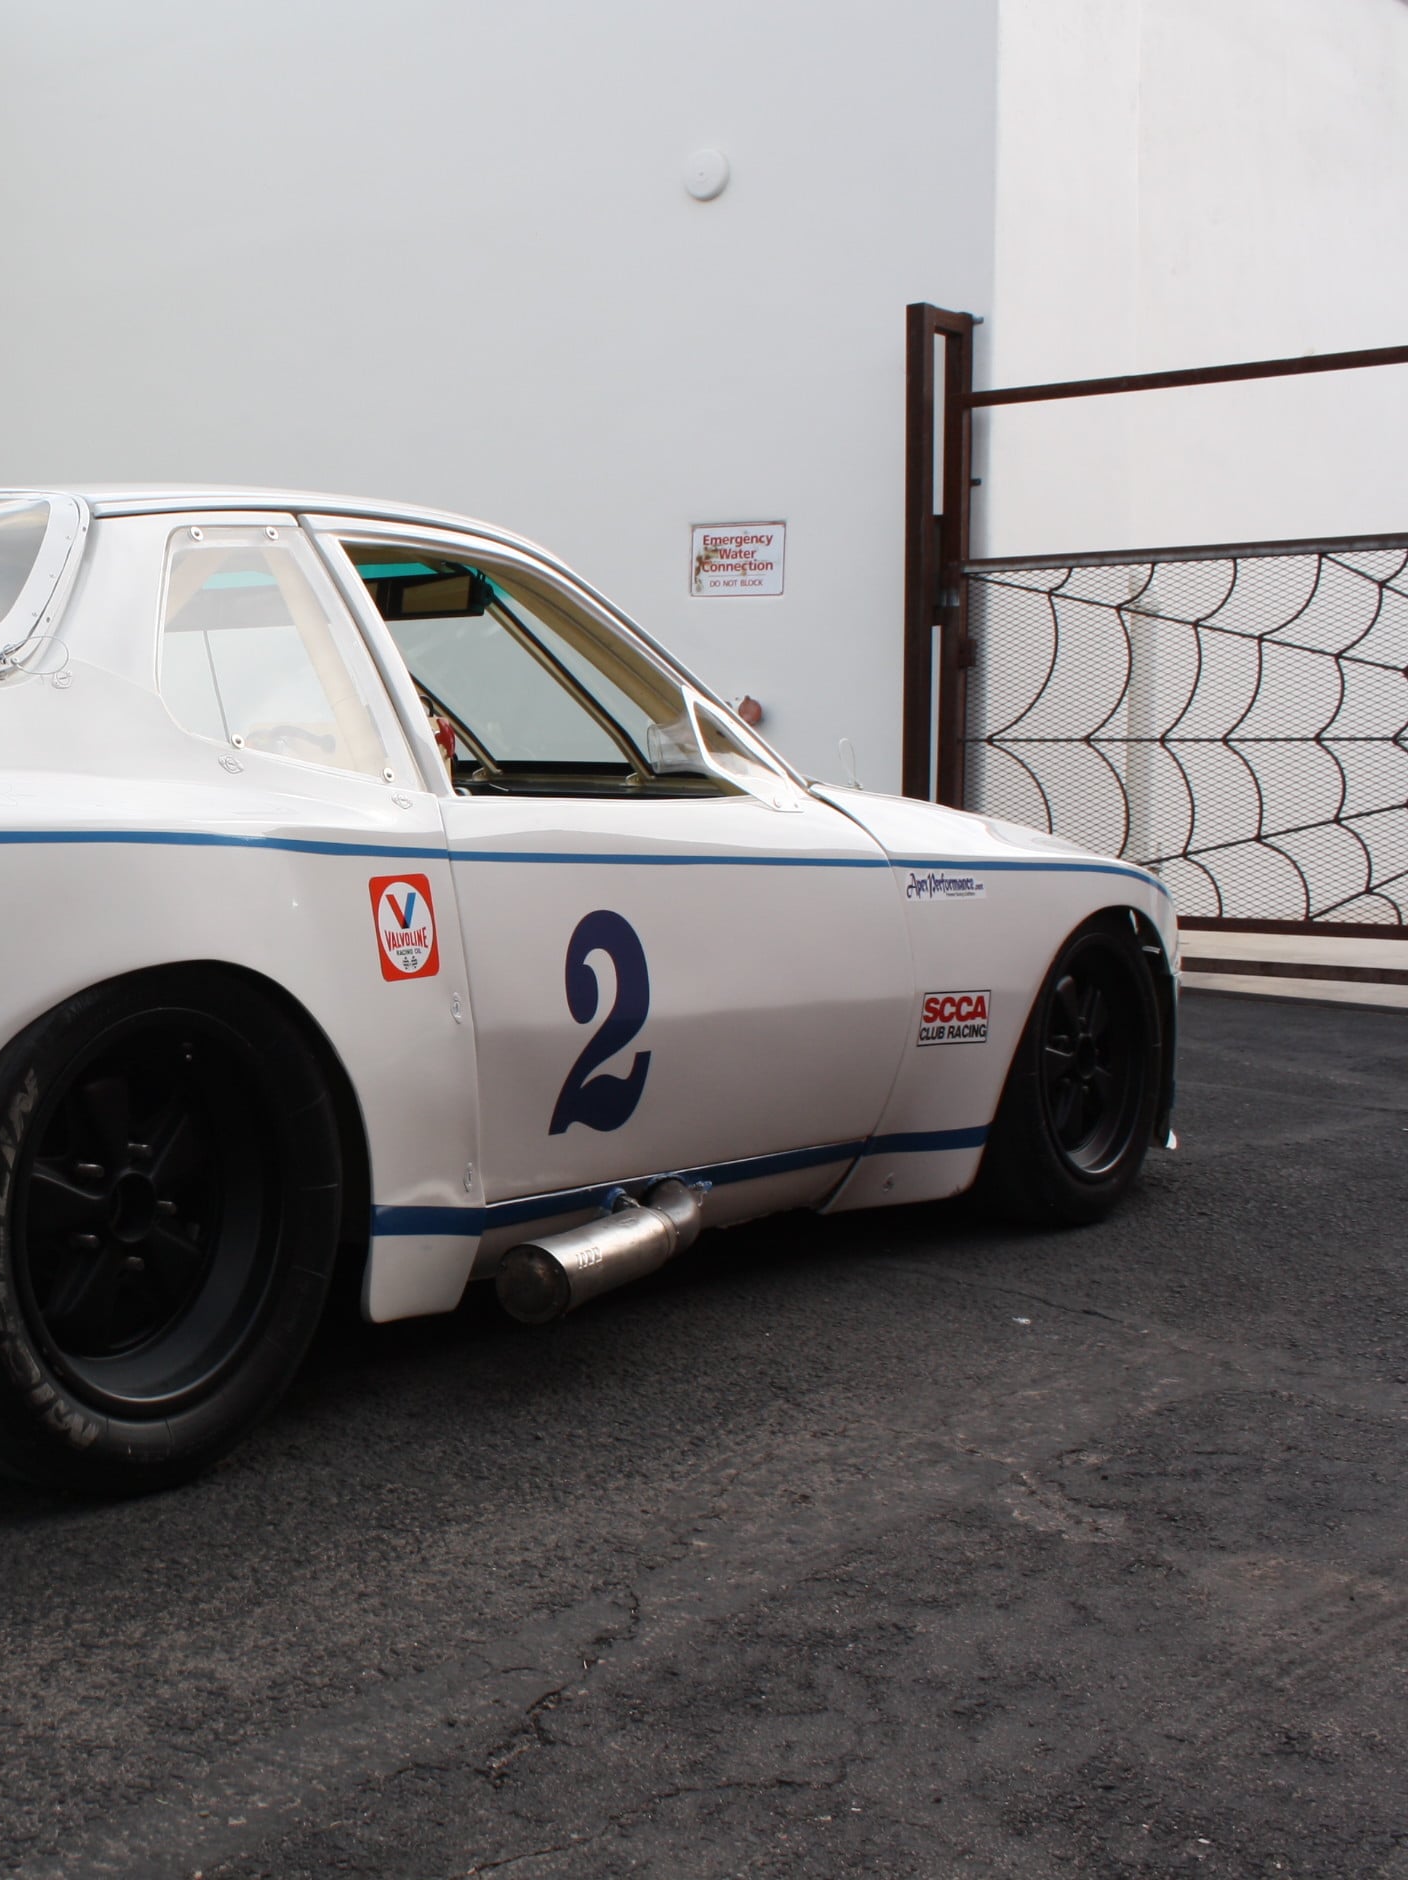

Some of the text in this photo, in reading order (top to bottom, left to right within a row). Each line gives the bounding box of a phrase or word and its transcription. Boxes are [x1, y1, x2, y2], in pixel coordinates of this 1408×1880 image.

[703, 535, 773, 547] Emergency
[719, 548, 757, 560] Water
[702, 561, 773, 572] Connection
[709, 579, 763, 588] DO NOT BLOCK
[384, 926, 429, 952] VALVOLINE
[923, 995, 987, 1023] SCCA
[548, 909, 652, 1136] 2
[919, 1023, 988, 1041] CLUB RACING
